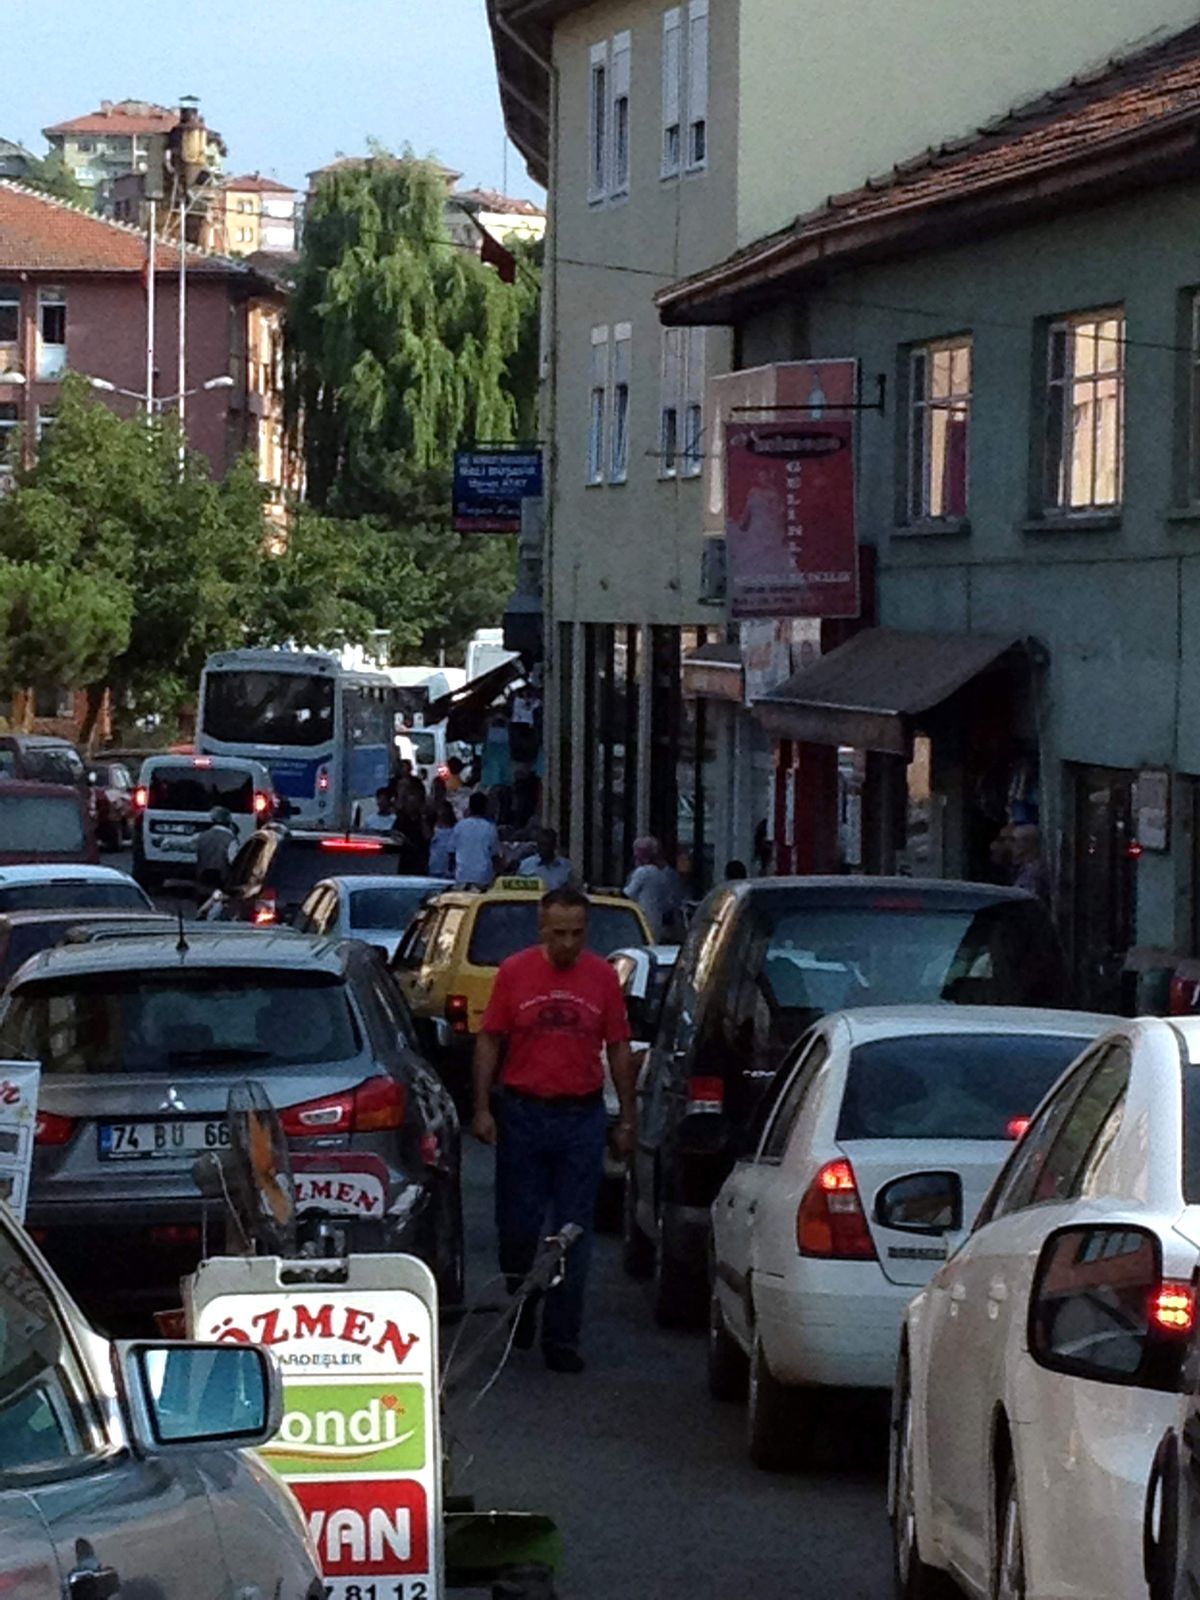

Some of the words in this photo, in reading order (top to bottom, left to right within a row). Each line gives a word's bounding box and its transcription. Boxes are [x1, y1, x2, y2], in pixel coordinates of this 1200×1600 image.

[113, 1124, 139, 1150] 74
[205, 1122, 231, 1147] 66
[277, 1353, 363, 1368] ARDEŞLER
[280, 1396, 399, 1445] ondi
